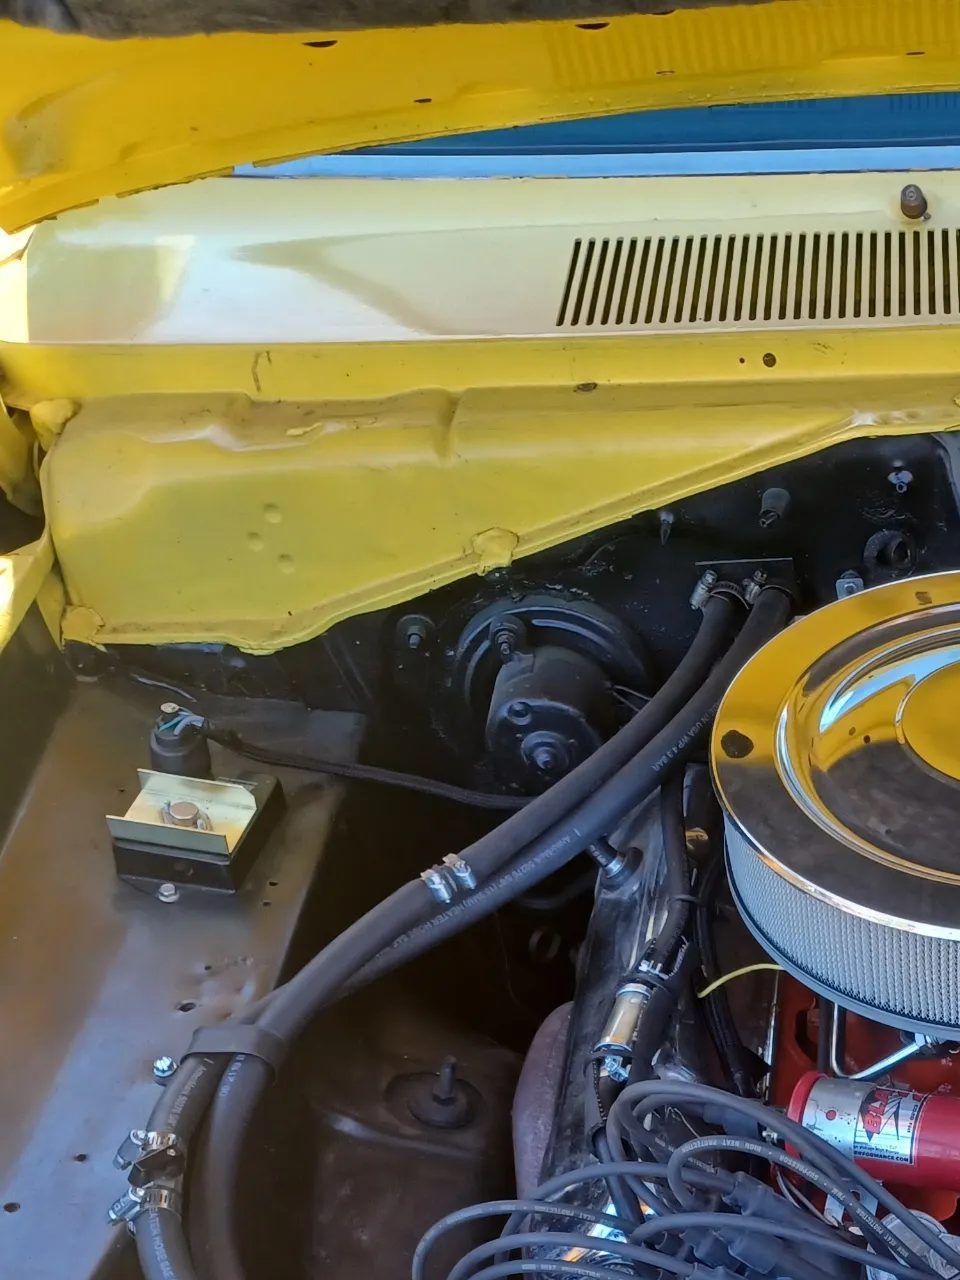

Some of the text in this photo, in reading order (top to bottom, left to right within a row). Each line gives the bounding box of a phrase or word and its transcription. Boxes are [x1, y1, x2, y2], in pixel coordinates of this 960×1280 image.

[651, 755, 669, 772] BAR
[433, 903, 464, 926] HEATER
[778, 1154, 820, 1181] SUPPRESSOR
[855, 1208, 884, 1234] PROTECTION
